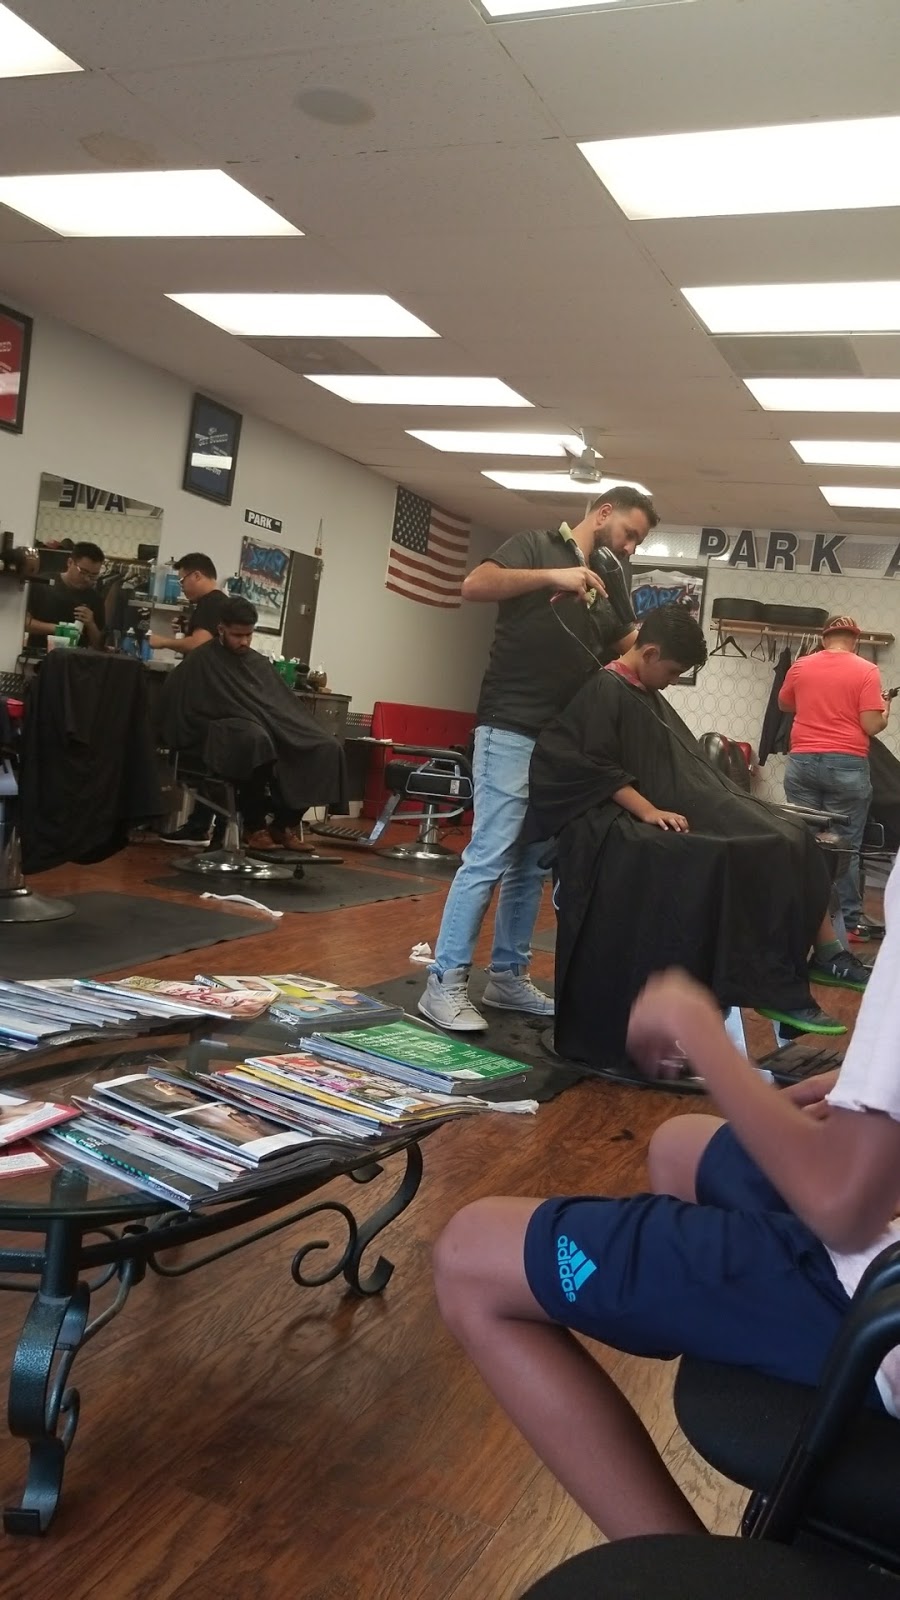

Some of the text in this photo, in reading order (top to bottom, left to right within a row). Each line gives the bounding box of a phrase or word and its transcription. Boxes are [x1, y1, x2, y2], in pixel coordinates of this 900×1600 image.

[248, 511, 273, 530] PARK
[700, 527, 848, 575] PARK
[557, 1235, 576, 1302] adidas
